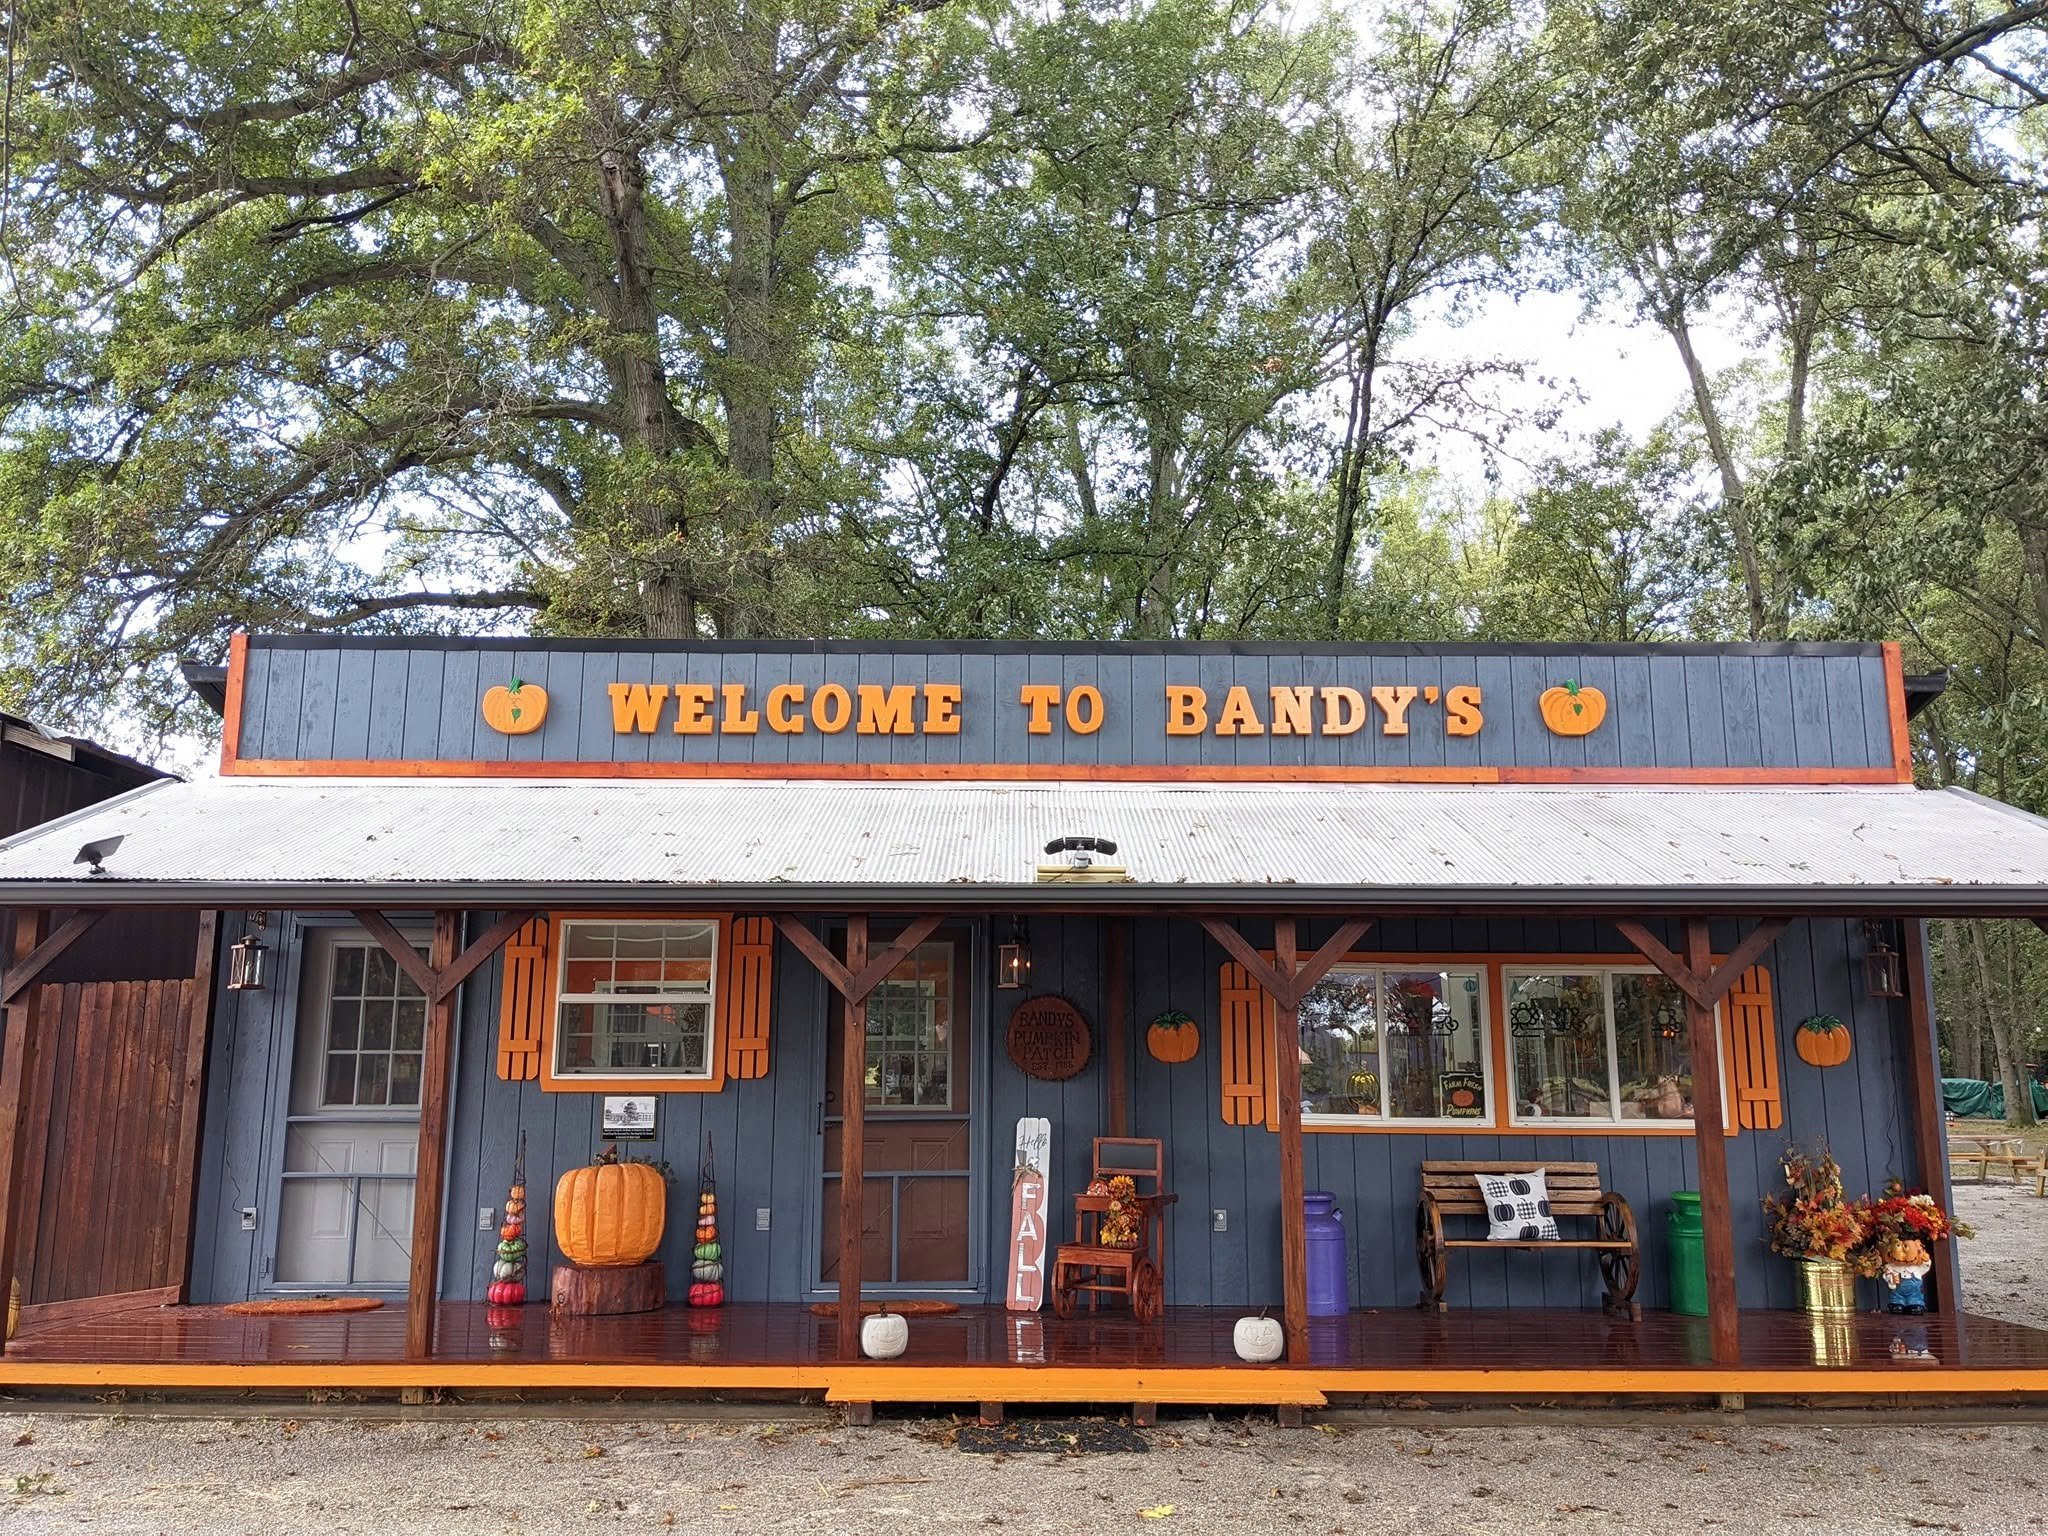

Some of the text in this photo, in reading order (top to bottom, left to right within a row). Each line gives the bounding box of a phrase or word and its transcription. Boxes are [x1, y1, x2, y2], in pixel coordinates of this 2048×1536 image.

[608, 683, 1485, 737] WELCOME TO BANDY'S
[1019, 1011, 1075, 1028] BANDYS
[1014, 1030, 1081, 1047] PUMPKIN
[1023, 1046, 1075, 1060] PATCH
[1443, 1077, 1483, 1091] FARM FRESH
[1446, 1104, 1482, 1115] PUMPKINS
[1018, 1133, 1048, 1151] Hello
[1016, 1182, 1041, 1302] FALL
